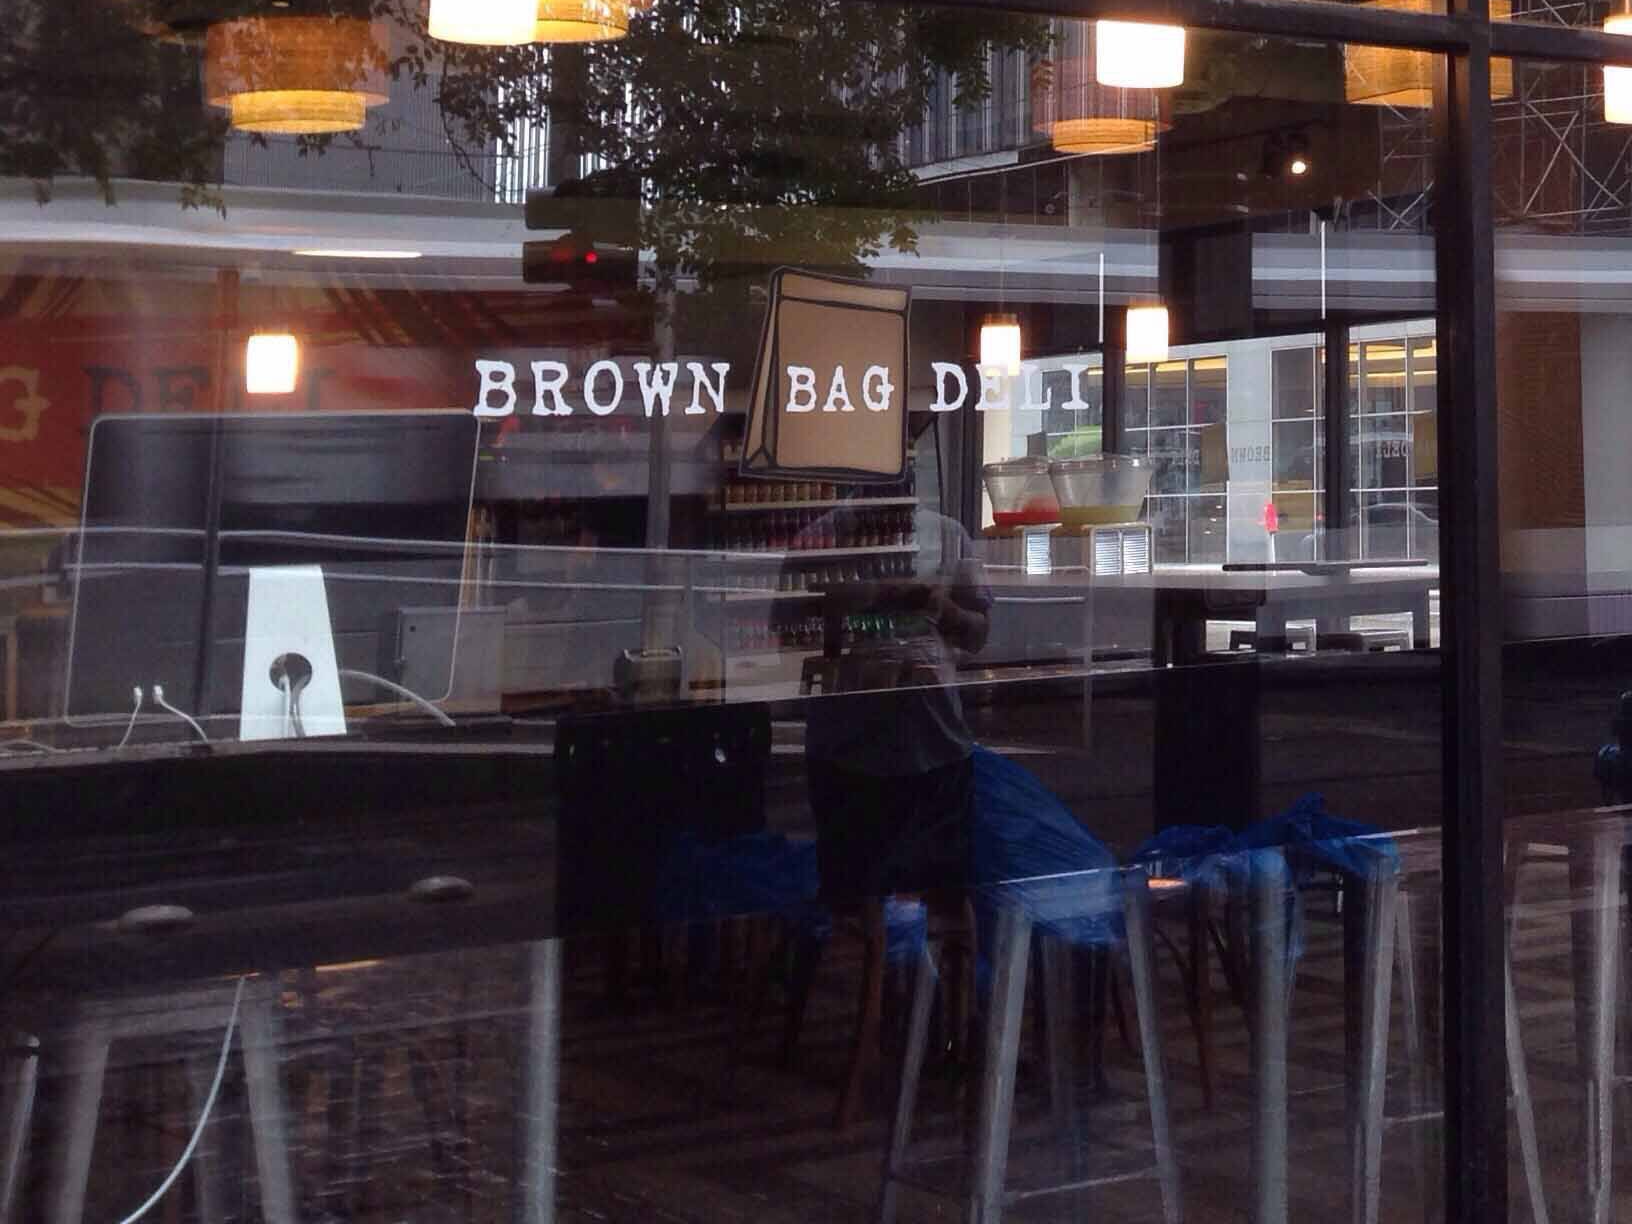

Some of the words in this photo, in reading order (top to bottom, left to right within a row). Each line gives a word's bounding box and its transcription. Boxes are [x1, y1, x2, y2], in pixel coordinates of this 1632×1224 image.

[473, 359, 731, 417] BROWN
[785, 365, 895, 413] BAG
[930, 362, 1091, 413] DELI
